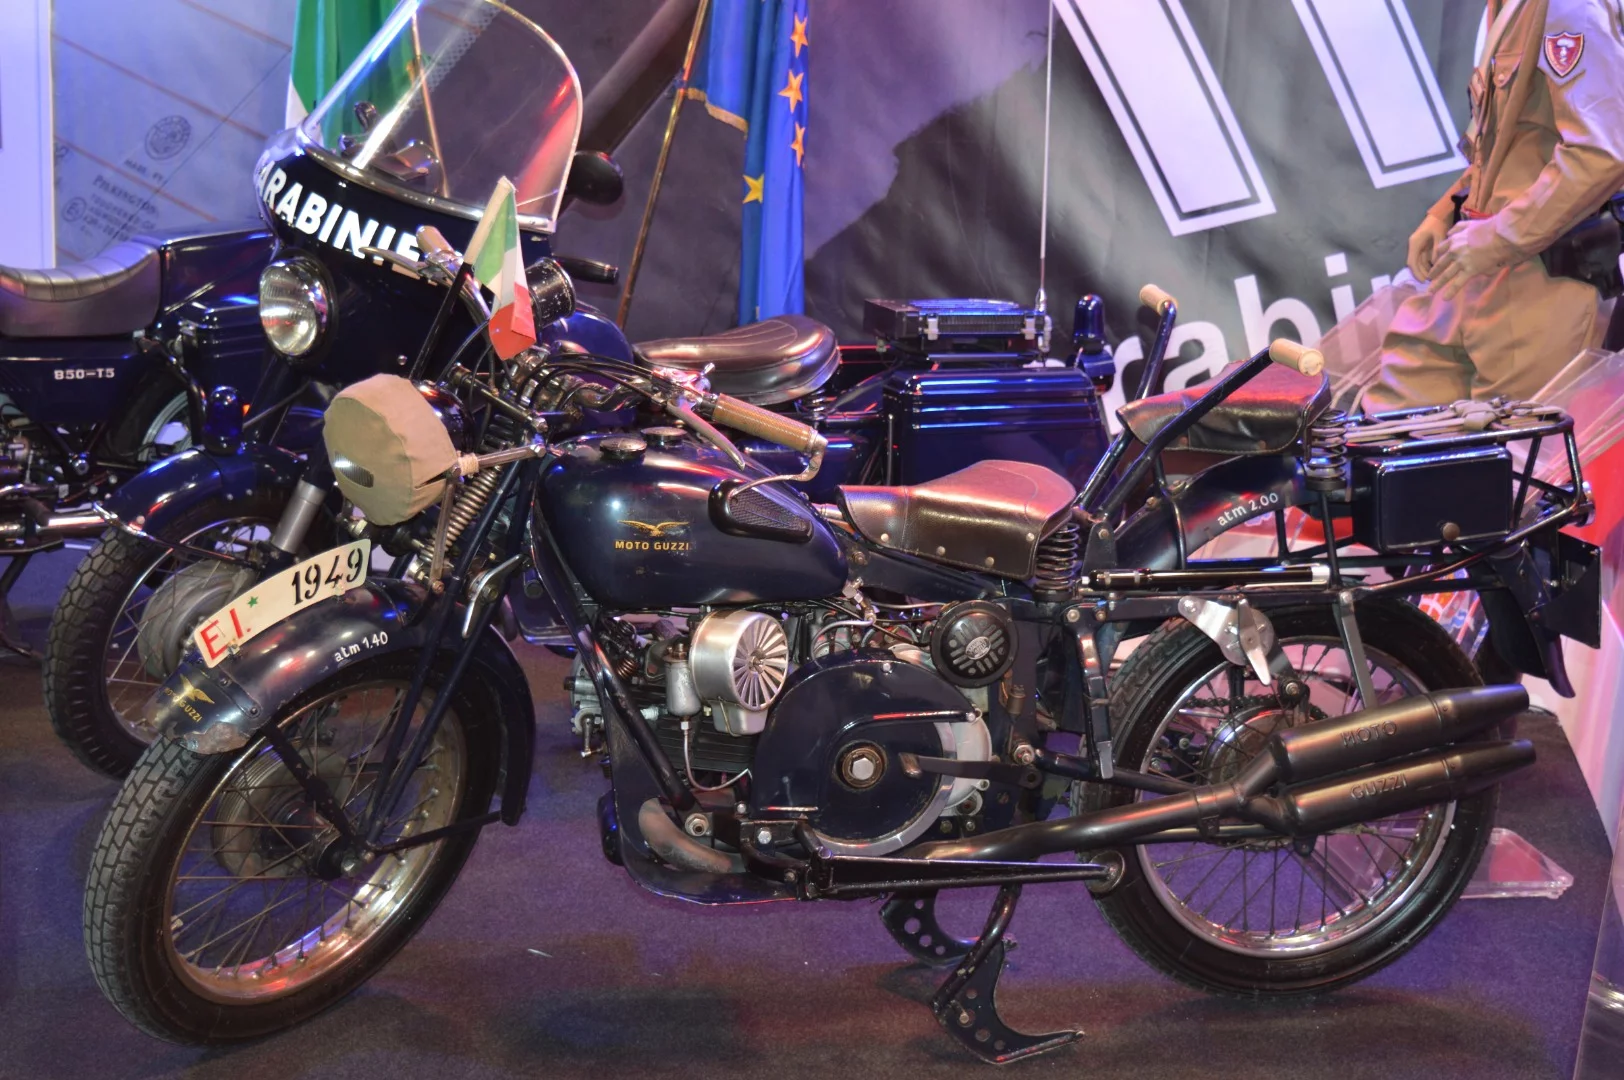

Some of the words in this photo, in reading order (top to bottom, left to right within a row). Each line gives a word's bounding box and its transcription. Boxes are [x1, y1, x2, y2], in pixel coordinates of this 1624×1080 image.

[255, 160, 421, 279] ARABINIE
[54, 367, 115, 380] 850-T5
[1217, 505, 1247, 526] atm
[614, 540, 650, 550] MOTO
[653, 541, 690, 551] GUZZI
[291, 548, 364, 606] 1949
[334, 643, 361, 662] atm
[180, 700, 203, 722] GUZZI
[1341, 720, 1398, 747] MOTO
[1351, 773, 1408, 800] GUZZI
